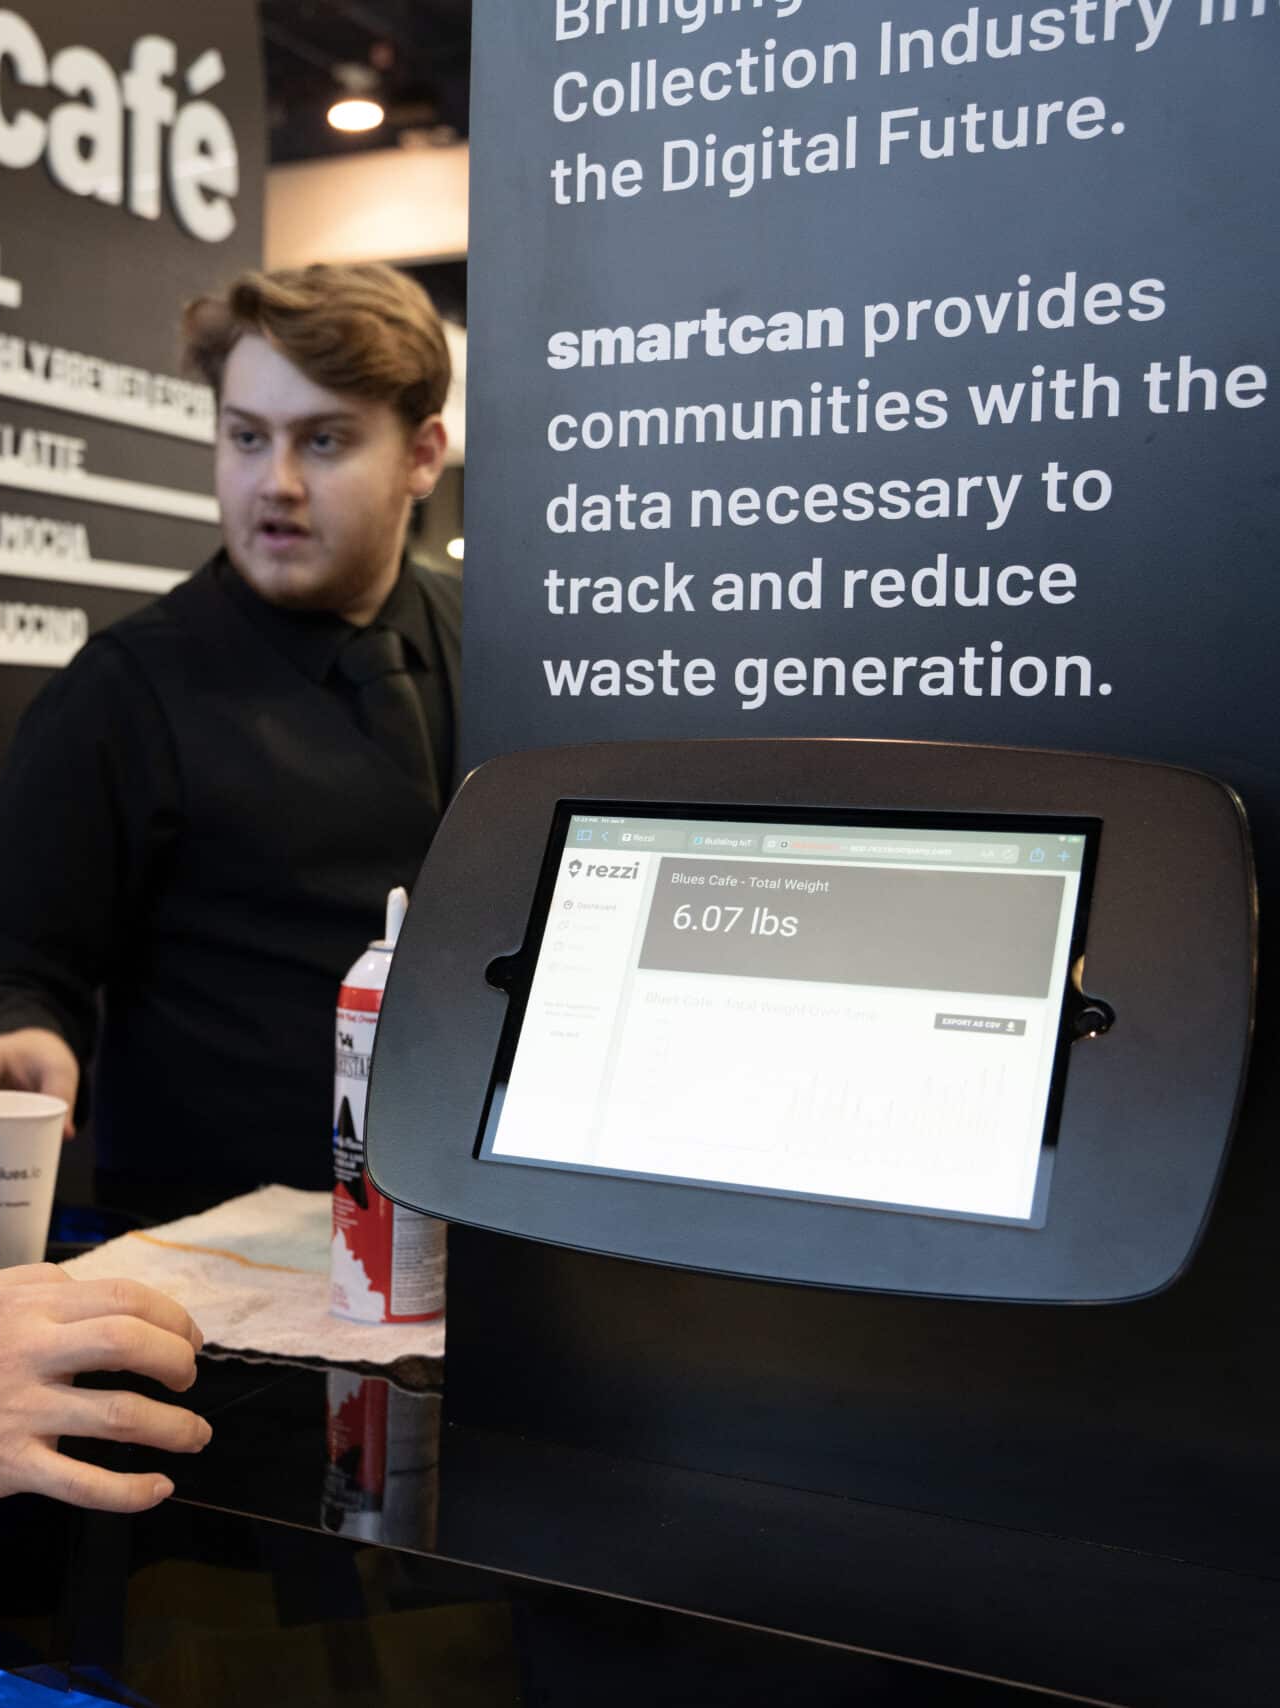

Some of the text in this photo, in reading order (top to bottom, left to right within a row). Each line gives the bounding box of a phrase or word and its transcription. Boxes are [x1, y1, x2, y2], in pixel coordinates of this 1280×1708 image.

[552, 0, 1173, 123] Collection Industry
[550, 96, 1125, 205] the Digital Future.
[546, 271, 1166, 370] smartcan provides
[547, 355, 1268, 452] communities with the
[546, 461, 1113, 534] data necessary to
[543, 552, 1077, 615] track and reduce
[542, 640, 1113, 710] waste generation.
[586, 861, 640, 880] rezzi
[671, 872, 705, 885] Blues
[708, 874, 738, 887] Cafe
[748, 876, 782, 889] Total
[784, 878, 830, 894] Weight
[672, 903, 799, 937] 6.07 lbs
